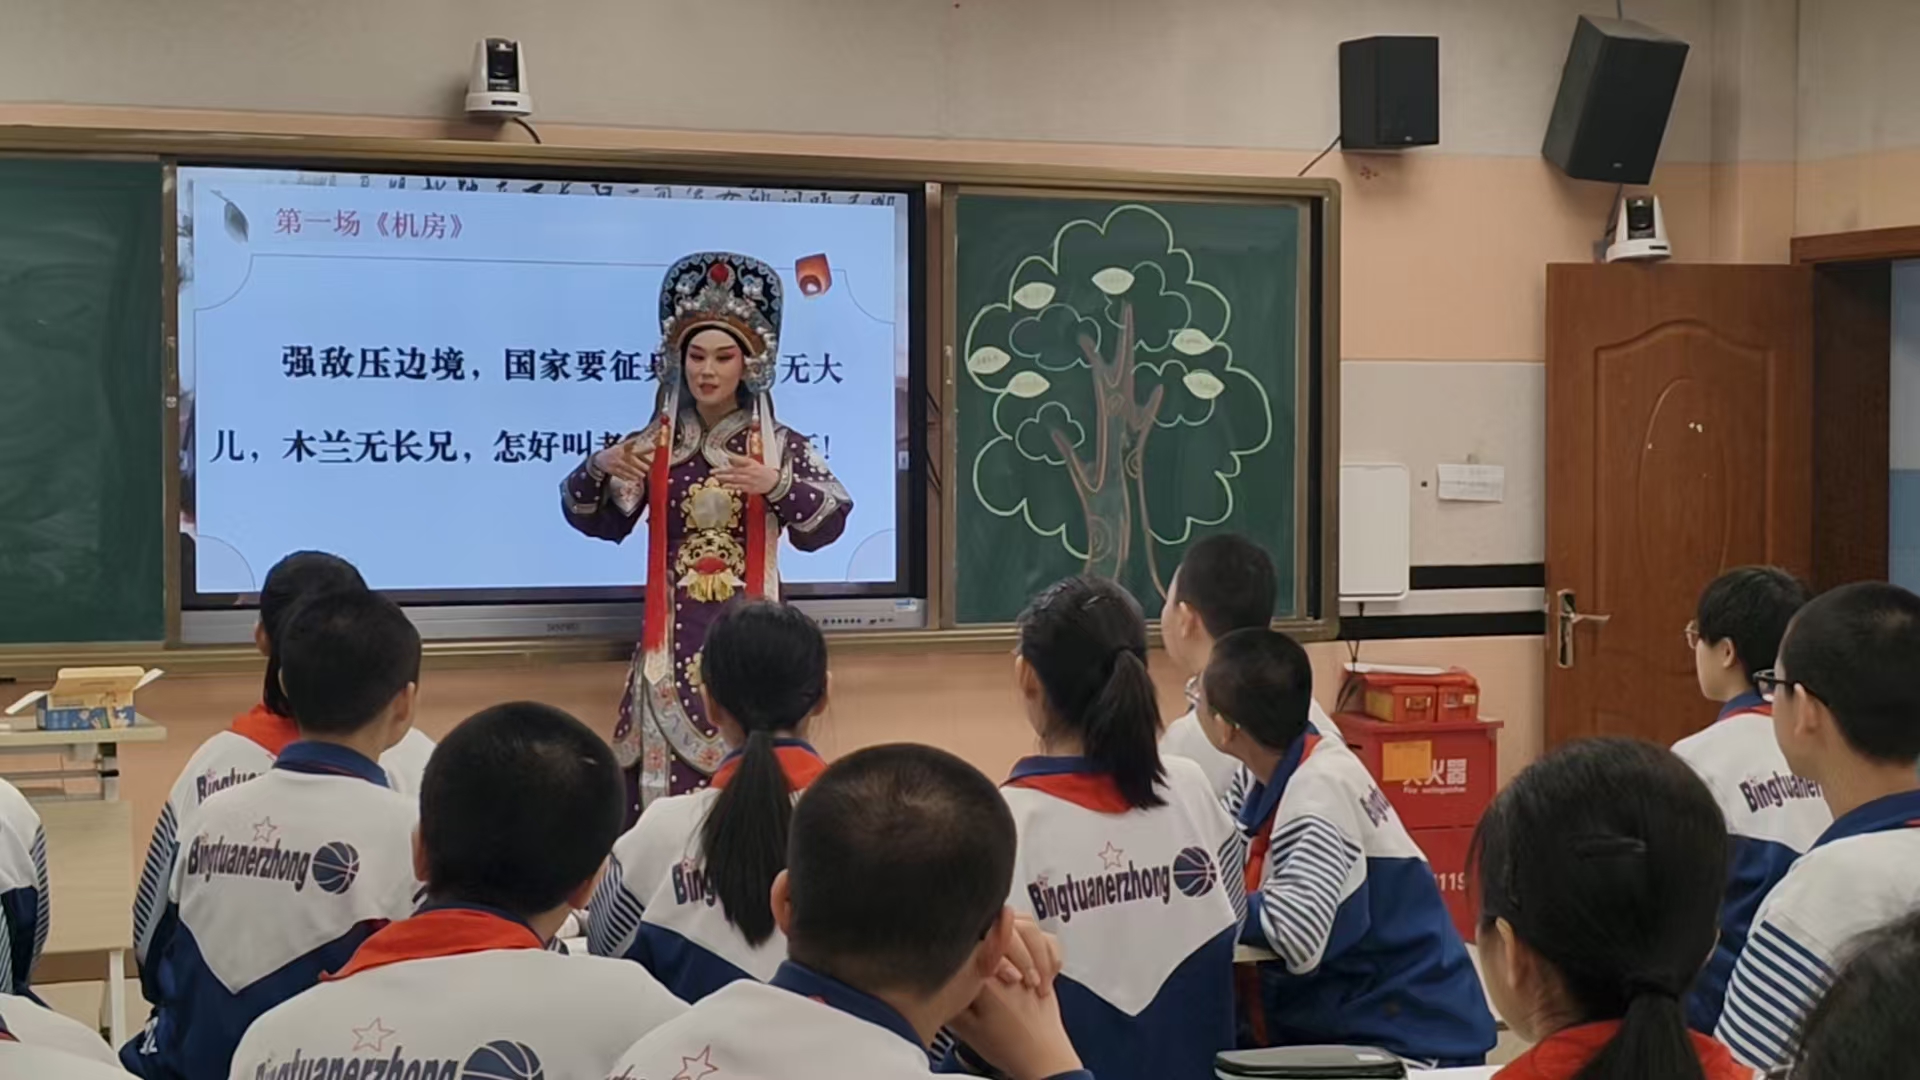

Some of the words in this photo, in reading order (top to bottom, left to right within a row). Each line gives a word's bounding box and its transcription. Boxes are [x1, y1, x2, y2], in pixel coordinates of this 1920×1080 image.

[275, 207, 463, 240] 第一场《机房》
[1028, 860, 1171, 923] Bingtuanerzhong
